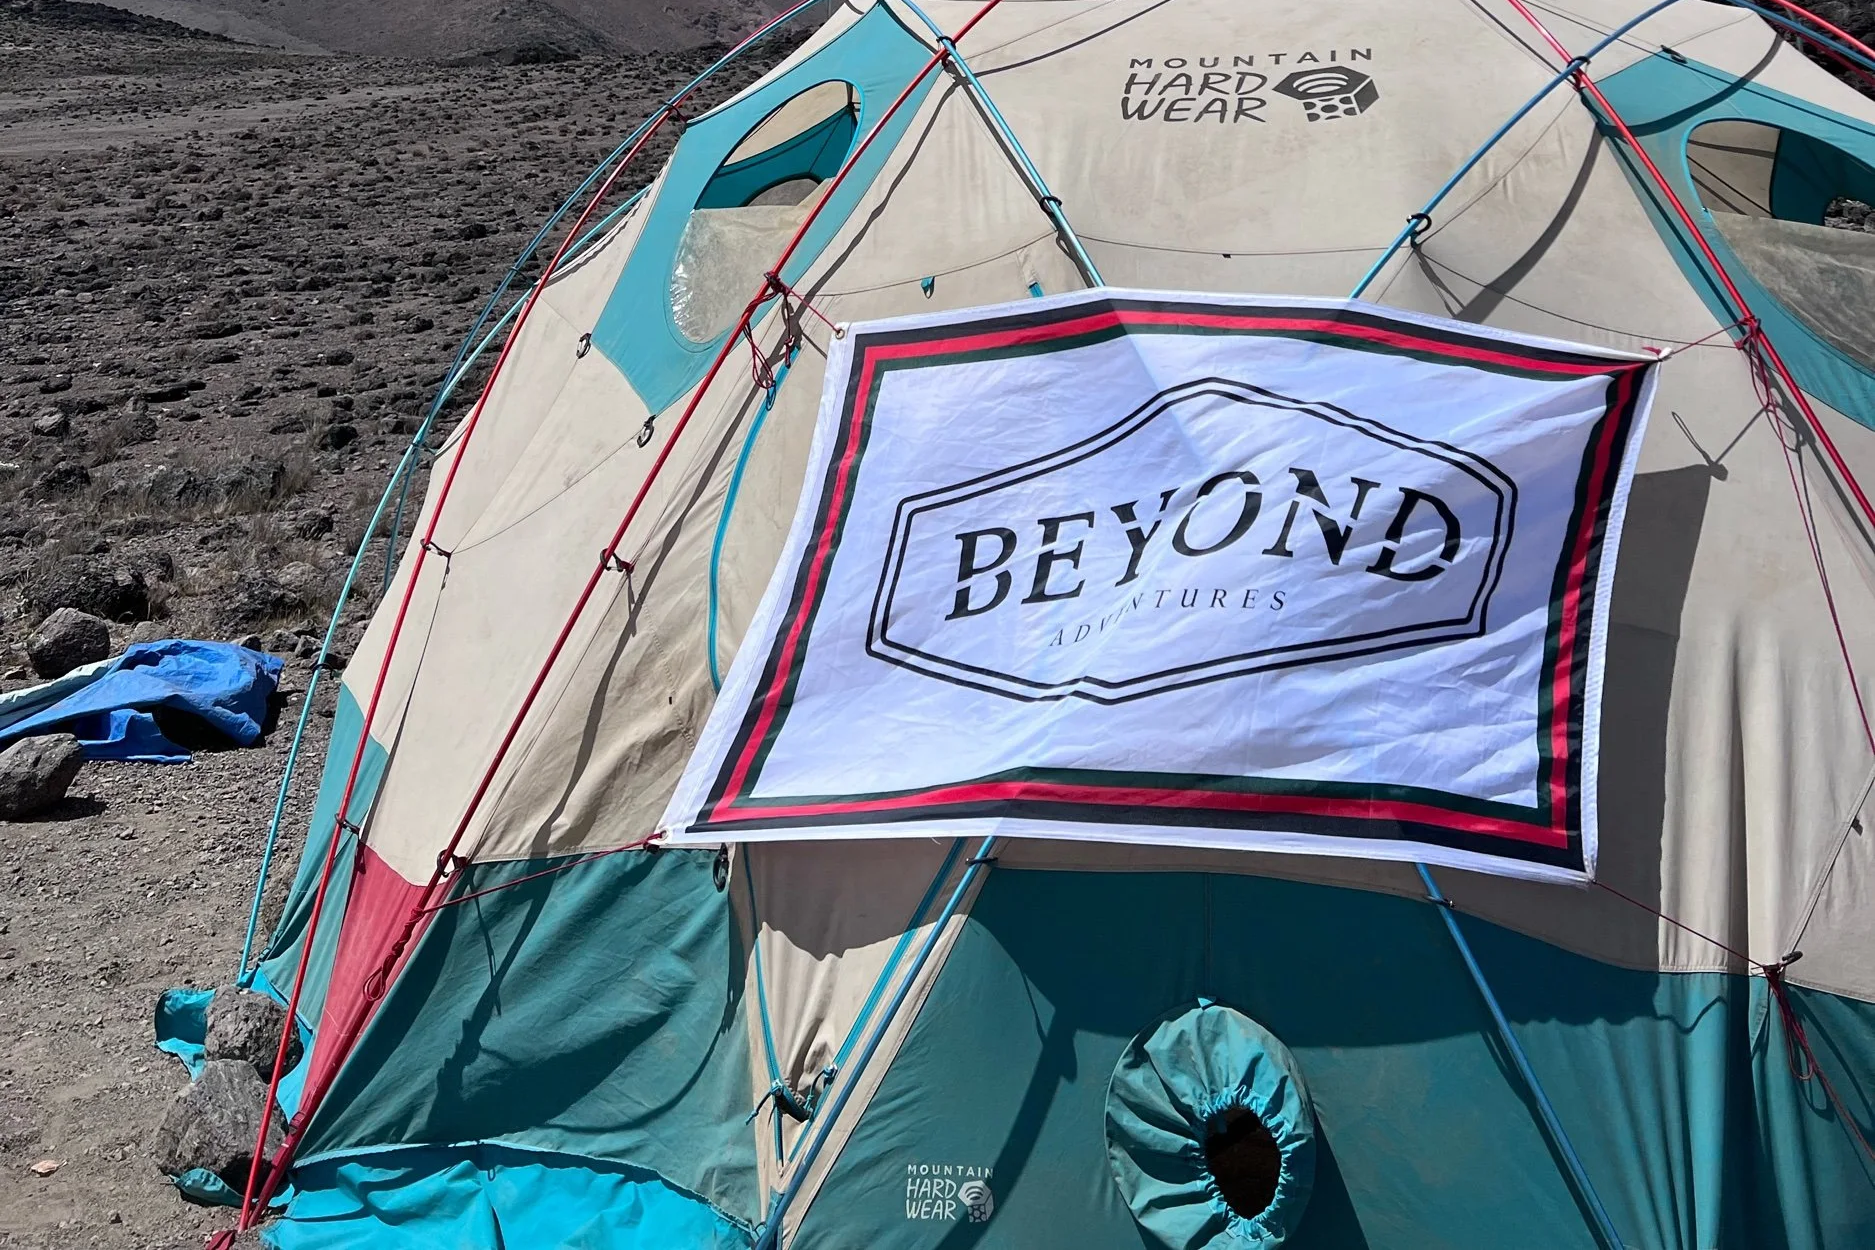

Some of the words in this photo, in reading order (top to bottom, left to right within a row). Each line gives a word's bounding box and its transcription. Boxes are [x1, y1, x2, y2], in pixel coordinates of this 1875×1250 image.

[1129, 48, 1372, 69] MOUNTAIN
[1123, 71, 1268, 96] HARD
[1120, 96, 1267, 124] WEAR
[945, 467, 1462, 622] BEYOND
[1049, 587, 1287, 647] ADVNTURES
[907, 1164, 994, 1179] MOUNTAIN
[906, 1178, 957, 1199] HARD
[905, 1199, 957, 1221] WEAR
